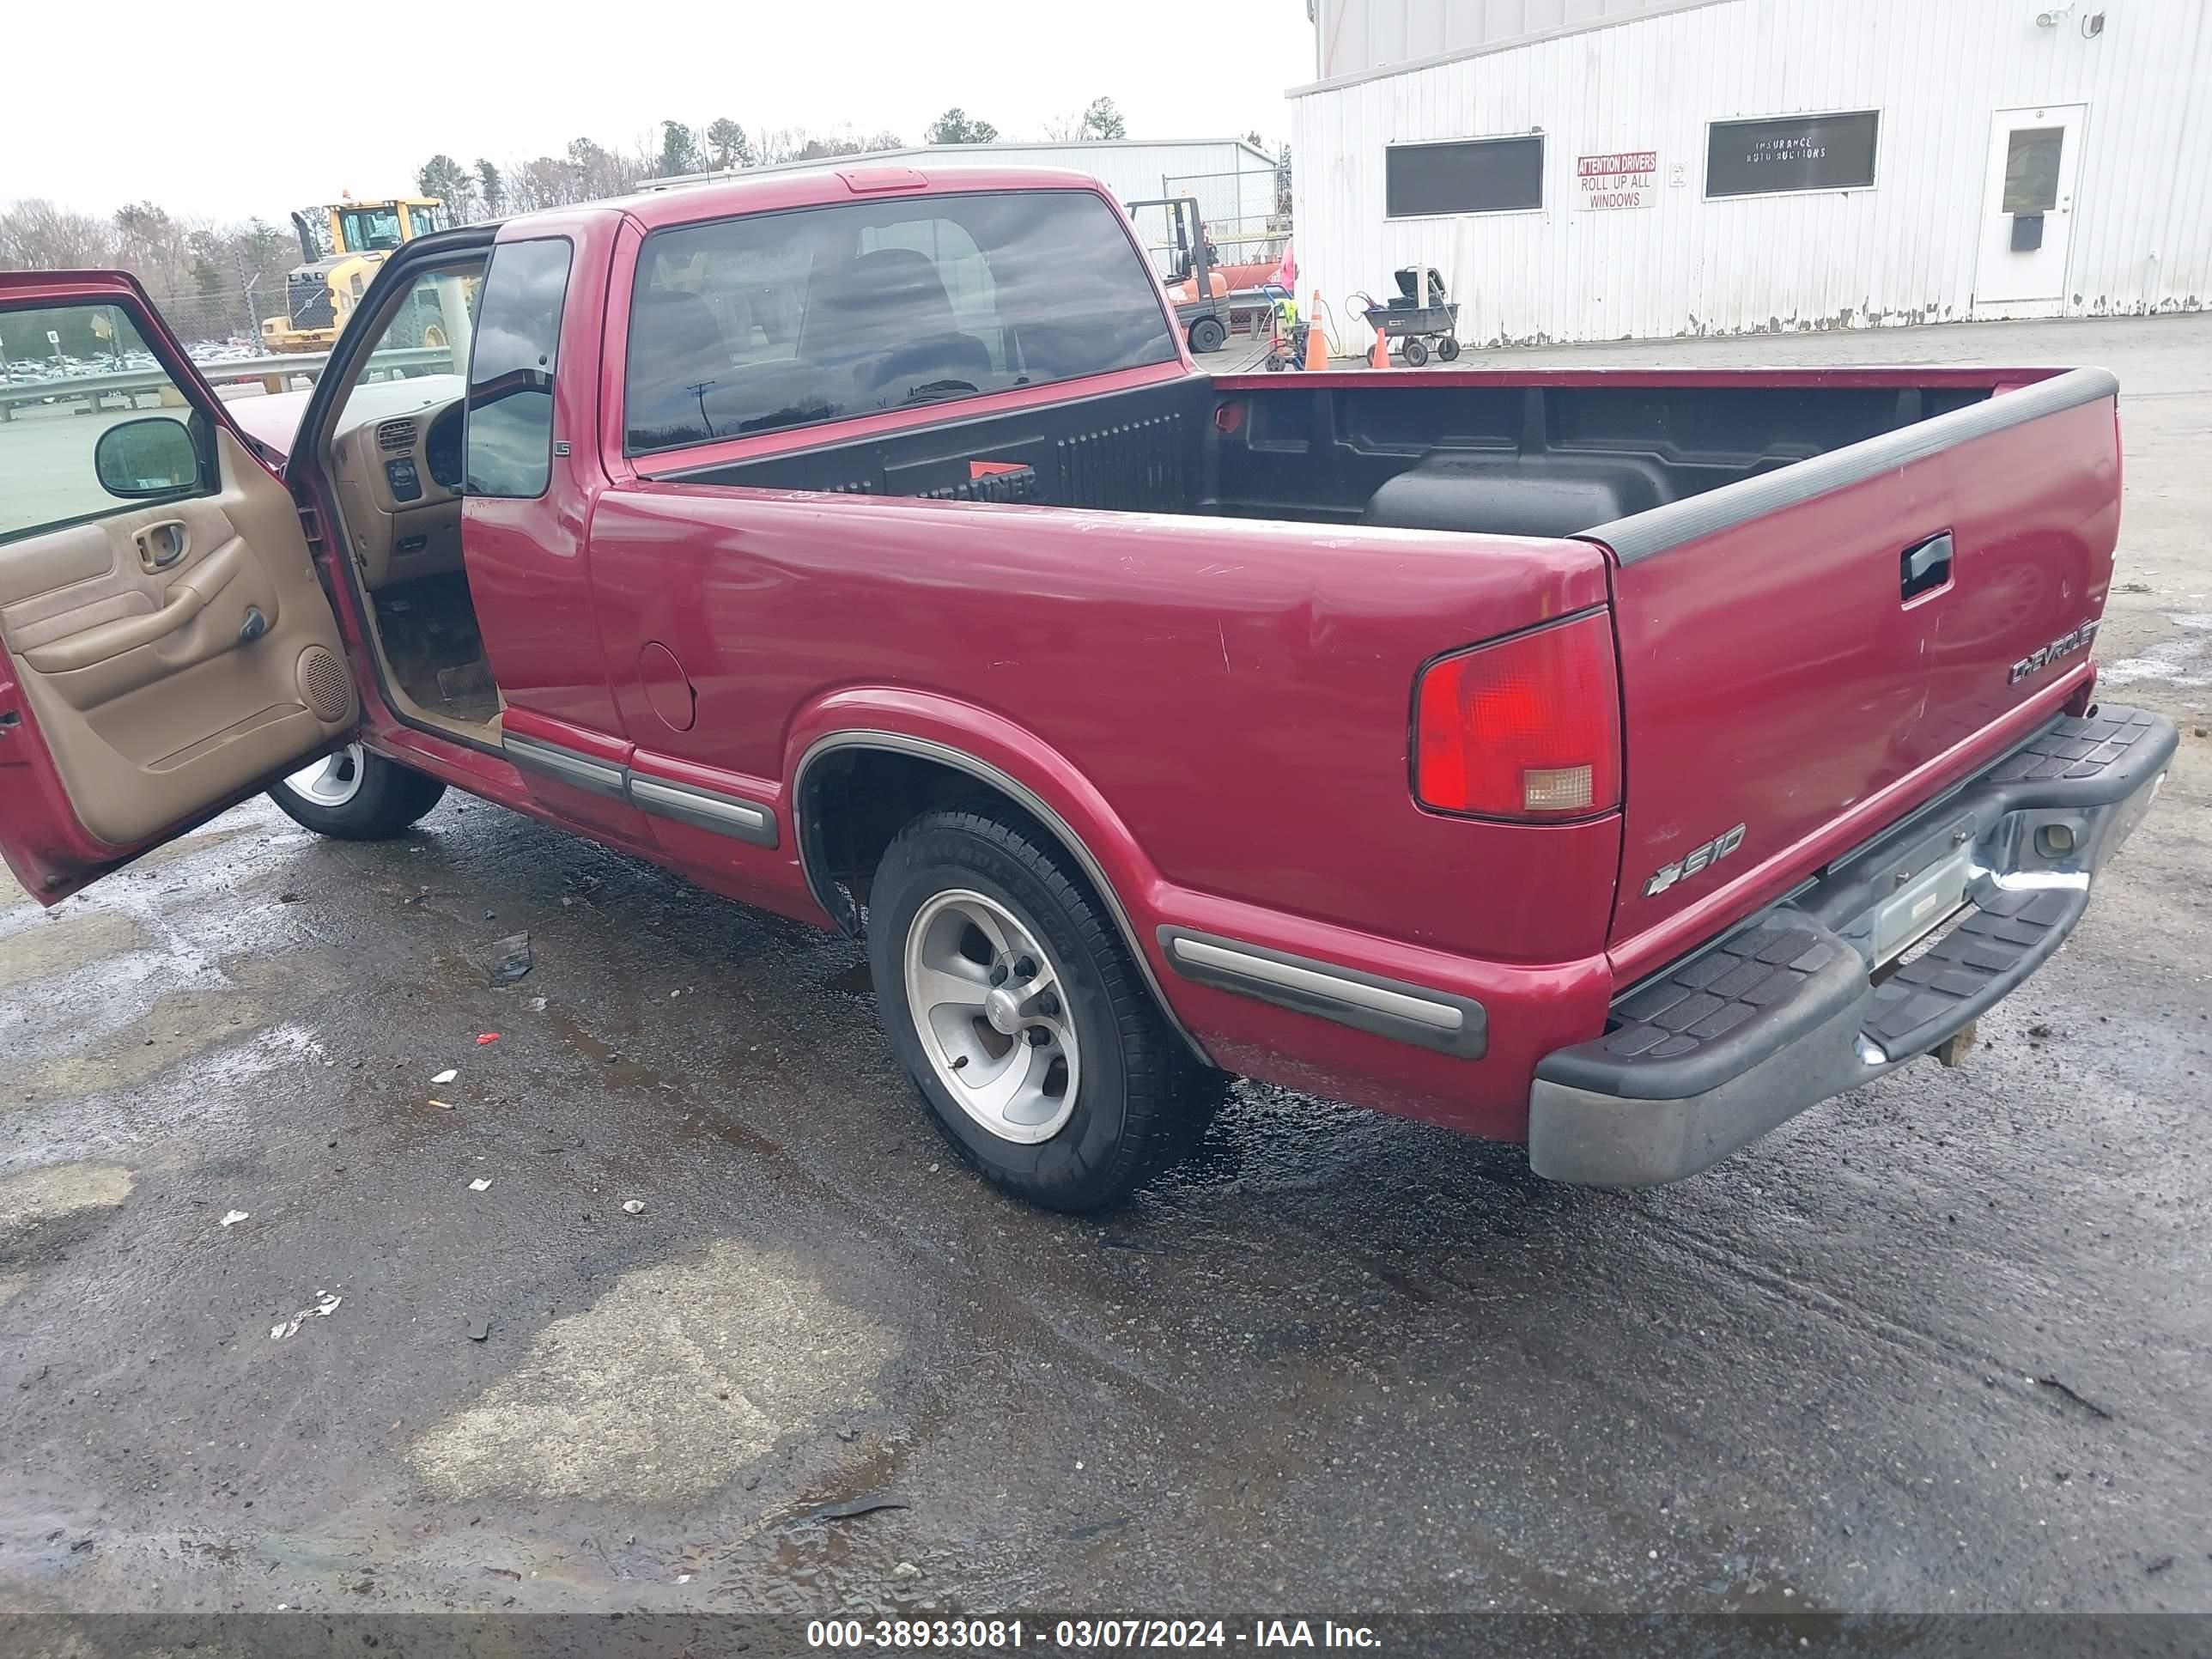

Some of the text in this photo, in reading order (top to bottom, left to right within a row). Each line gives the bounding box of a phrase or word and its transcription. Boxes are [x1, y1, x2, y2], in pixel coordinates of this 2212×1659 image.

[1756, 137, 1812, 149] INSURANCE
[1579, 154, 1656, 175] ATTENTION DRIVERS
[1581, 173, 1650, 191] ROLL UP ALL
[1589, 191, 1640, 209] WINDOWS
[555, 440, 571, 457] LS
[1680, 822, 1747, 881] S10
